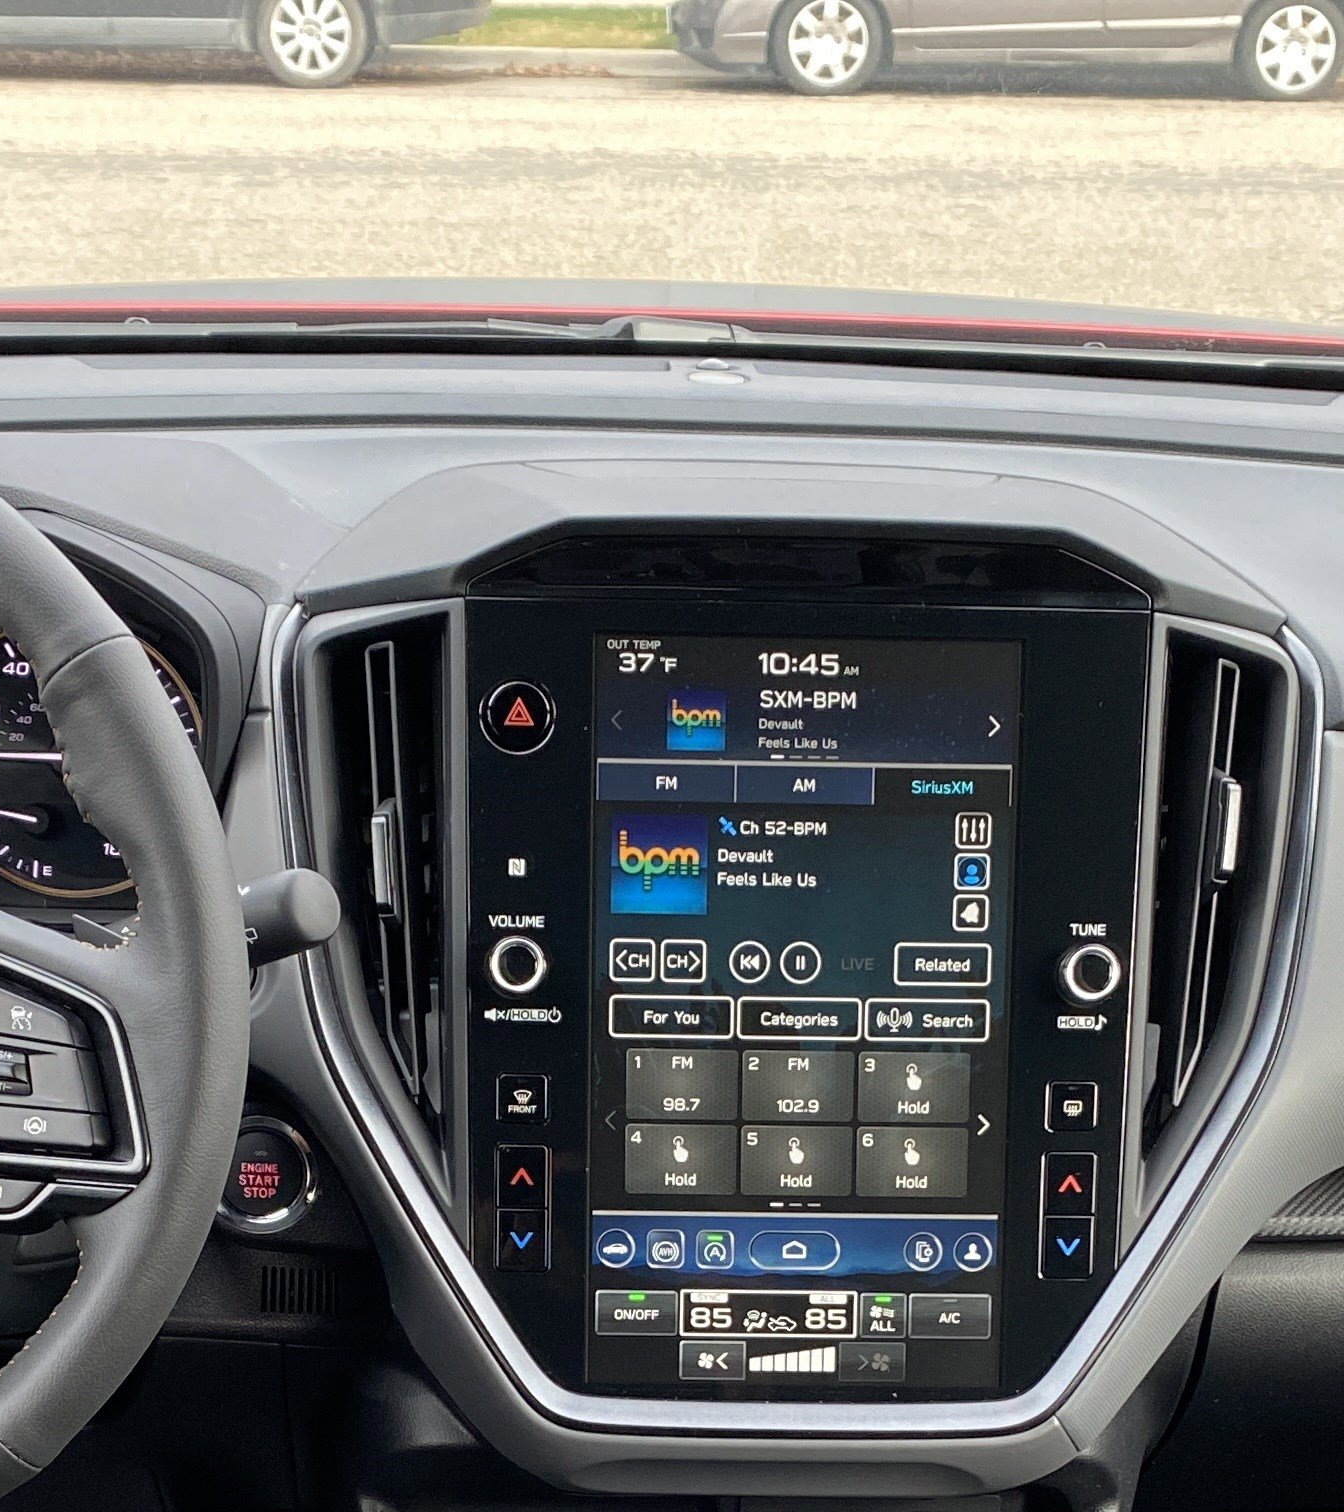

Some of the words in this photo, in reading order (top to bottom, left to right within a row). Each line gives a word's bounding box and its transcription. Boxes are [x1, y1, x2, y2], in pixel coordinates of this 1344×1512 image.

[607, 640, 629, 649] OUT
[633, 640, 661, 649] TEMP
[2, 662, 29, 676] 40
[618, 654, 654, 673] 37
[758, 653, 839, 675] 10:45
[844, 666, 859, 675] AM
[760, 691, 856, 709] SXM-BPM
[17, 716, 32, 724] 40
[758, 718, 804, 730] Devault
[9, 733, 24, 741] 20
[758, 737, 790, 750] Feels
[794, 737, 817, 750] Like
[822, 738, 837, 750] Us
[656, 777, 677, 790] FM
[793, 779, 815, 792] AM
[911, 780, 973, 794] SiriusXM
[740, 821, 758, 834] Ch
[765, 821, 826, 835] 52-BPM
[618, 830, 700, 891] bpm
[718, 849, 773, 862] Devault
[43, 866, 52, 875] E
[717, 873, 756, 887] Feels
[763, 873, 792, 887] Like
[797, 874, 816, 887] Us
[489, 915, 544, 927] VOLUME
[1070, 924, 1106, 936] TUNE
[841, 957, 874, 971] LIVE
[915, 958, 970, 972] Related
[512, 1010, 546, 1020] HOLD
[644, 1011, 669, 1024] For
[675, 1011, 699, 1025] You
[761, 1012, 838, 1028] Categories
[922, 1014, 973, 1028] Search
[1058, 1018, 1093, 1027] HOLD
[635, 1057, 641, 1068] 1
[672, 1057, 693, 1069] FM
[749, 1058, 758, 1070] 2
[788, 1059, 809, 1070] FM
[865, 1060, 875, 1071] 3
[508, 1105, 537, 1113] FRONT
[663, 1099, 700, 1111] 98.7
[777, 1100, 819, 1112] 102.9
[898, 1101, 929, 1114] Hold
[631, 1132, 642, 1143] 4
[747, 1133, 758, 1145] 5
[862, 1134, 873, 1146] 6
[241, 1163, 278, 1173] ENGINE
[239, 1175, 280, 1186] START
[665, 1173, 696, 1187] Hold
[780, 1175, 812, 1188] Hold
[895, 1176, 927, 1189] Hold
[244, 1187, 276, 1198] STOP
[614, 1308, 659, 1321] ON/OFF
[690, 1308, 731, 1328] 85
[805, 1309, 847, 1329] 85
[939, 1312, 960, 1324] A/C
[870, 1320, 895, 1332] ALL
